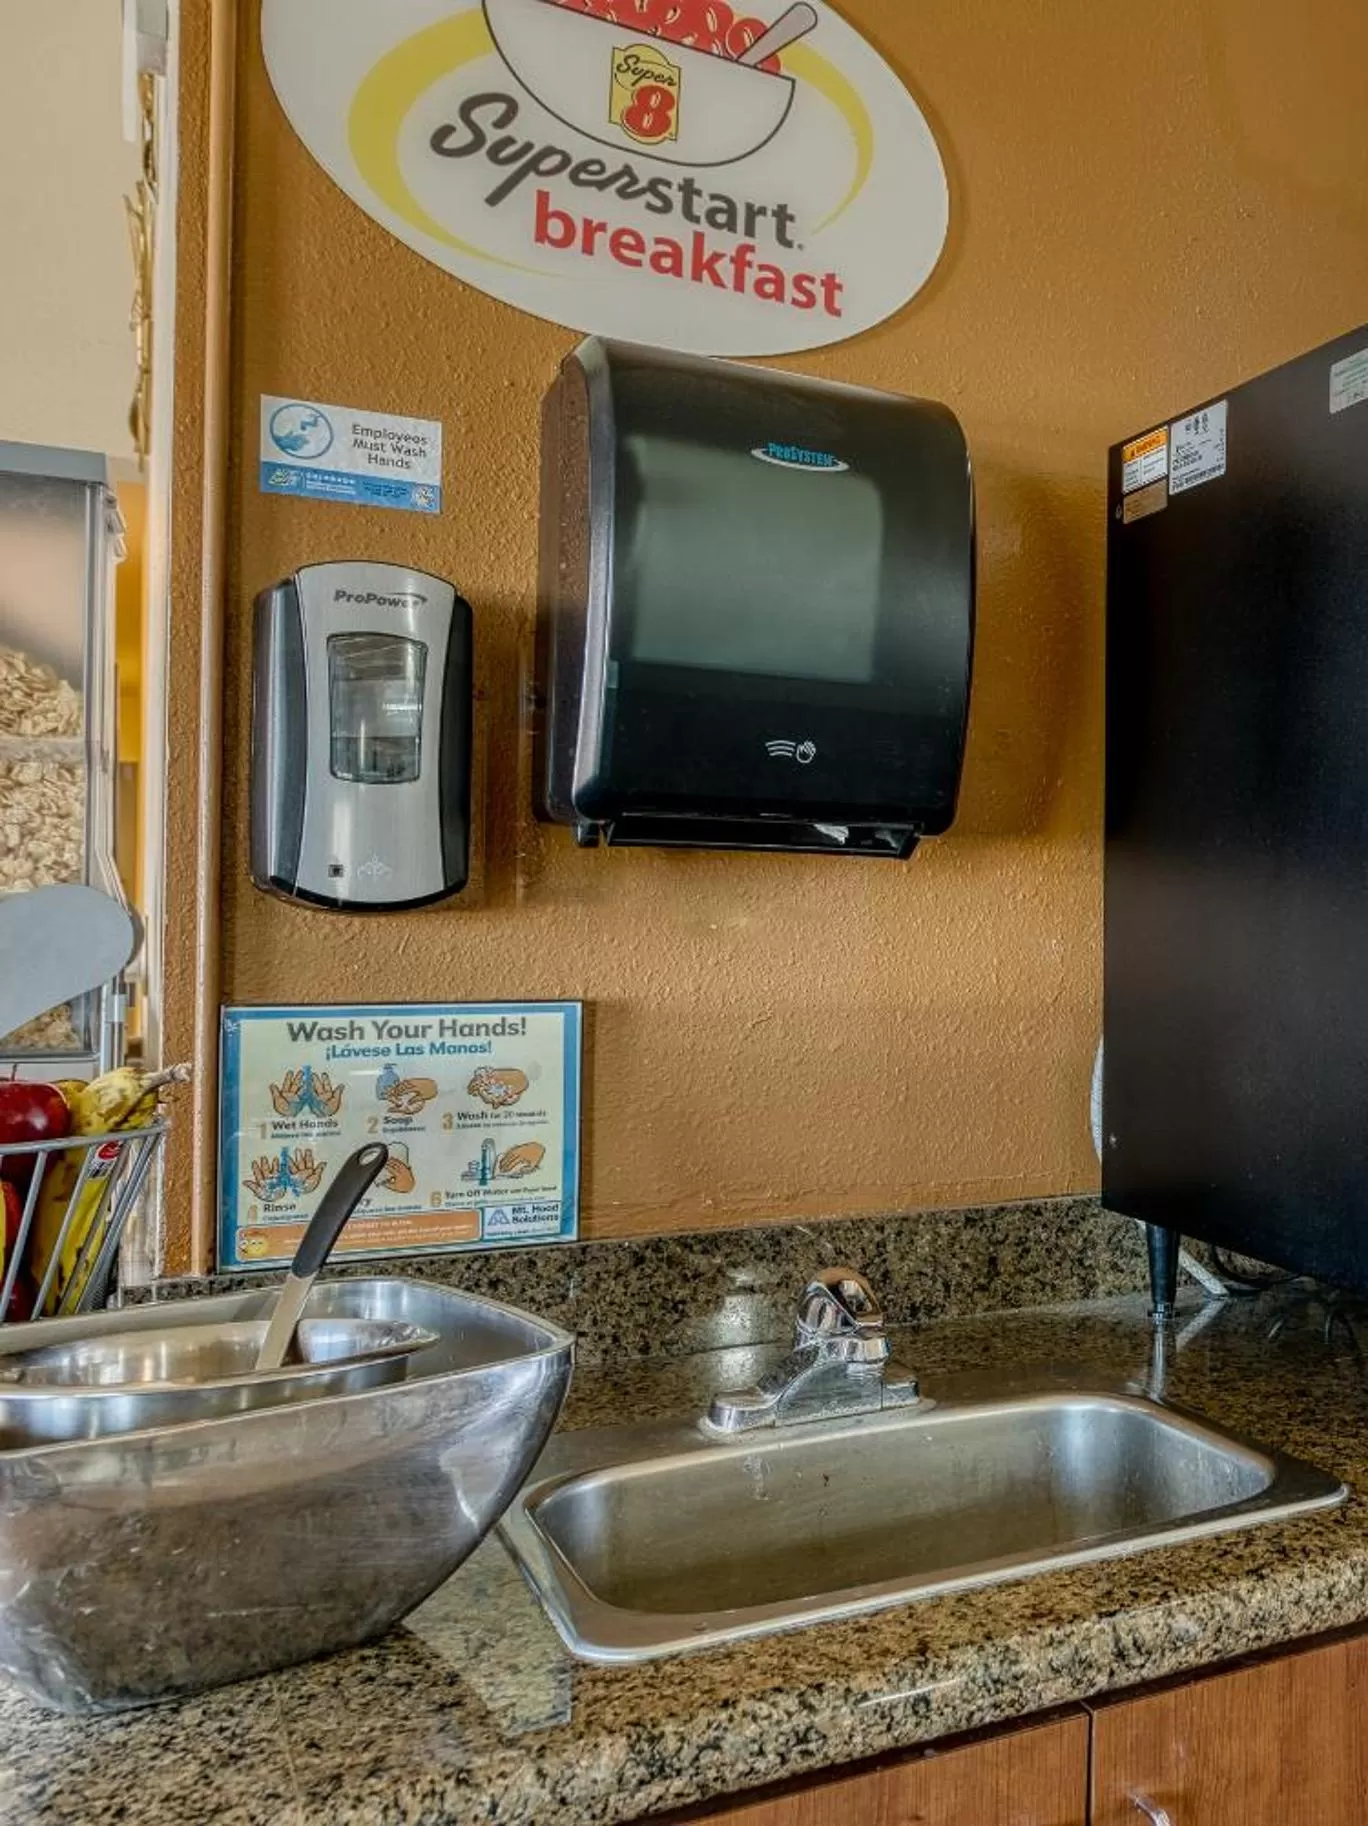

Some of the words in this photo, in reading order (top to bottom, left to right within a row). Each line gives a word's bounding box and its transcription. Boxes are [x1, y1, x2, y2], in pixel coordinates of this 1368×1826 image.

[616, 54, 677, 87] Super
[623, 85, 676, 138] 8
[430, 92, 796, 249] Superstart
[534, 189, 844, 318] breakfast
[352, 424, 428, 446] Employees
[353, 438, 386, 453] Must
[390, 442, 427, 458] Wash
[368, 453, 412, 469] Hands
[287, 1019, 365, 1042] Wash
[371, 1019, 433, 1040] Your
[438, 1016, 527, 1038] Hands!
[396, 1042, 425, 1056] Las
[429, 1040, 493, 1055] Manos!
[271, 1120, 296, 1131] Wet
[300, 1118, 339, 1129] Hands
[367, 1117, 379, 1134] 2
[457, 1110, 488, 1121] Wash
[263, 1202, 297, 1213] Rinse
